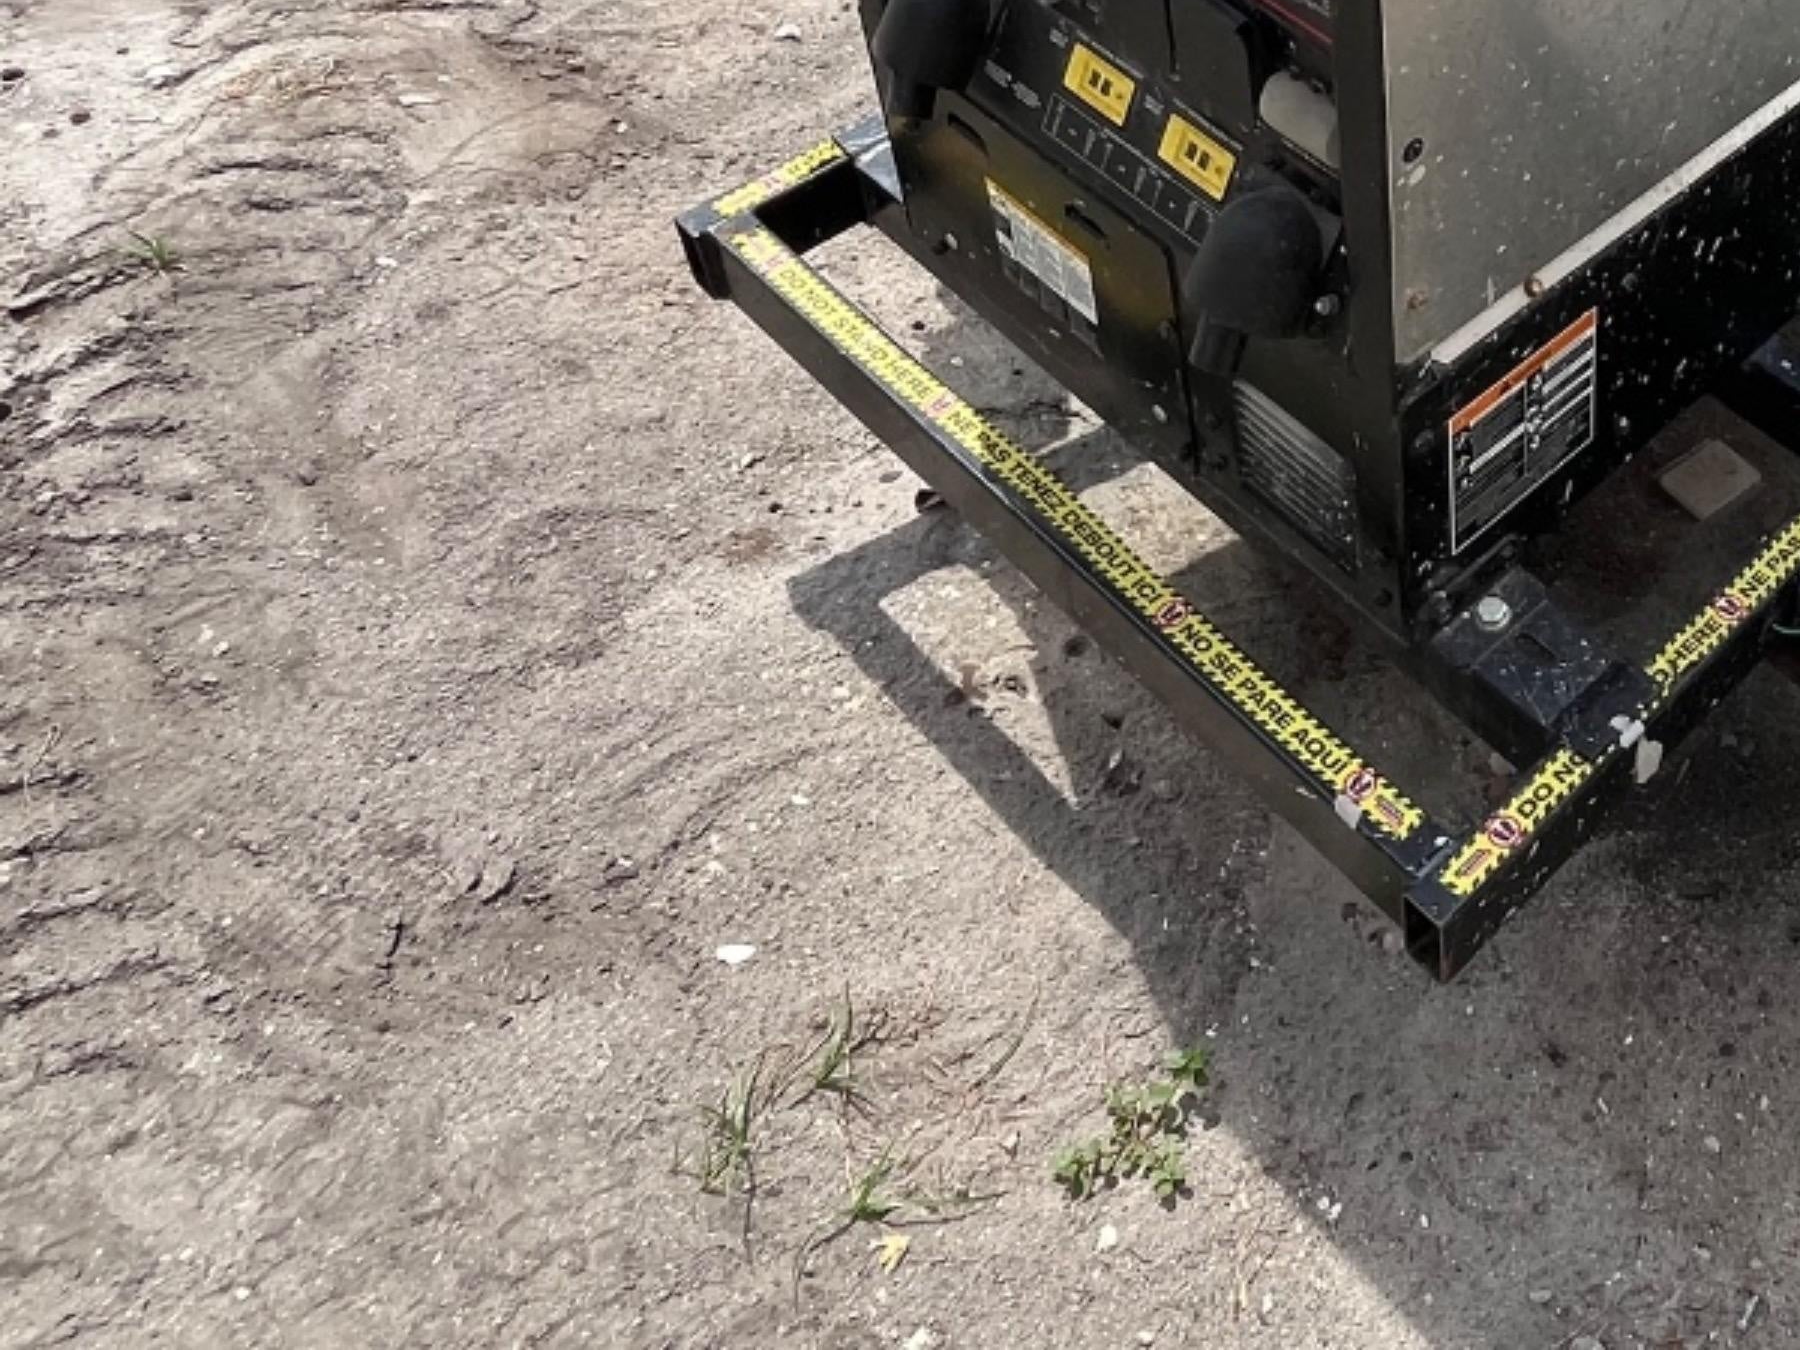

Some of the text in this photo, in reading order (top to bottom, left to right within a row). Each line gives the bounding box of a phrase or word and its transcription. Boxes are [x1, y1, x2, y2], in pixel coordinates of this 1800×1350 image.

[833, 317, 890, 362] STAD
[884, 358, 933, 399] HERE
[977, 430, 1012, 463] PAS
[1009, 461, 1067, 512] TENEZ
[1062, 508, 1139, 579] DEBOUT
[1131, 577, 1166, 603] ICI
[1178, 623, 1349, 775] NO SE PARE AQUI
[1517, 753, 1590, 819] DO NO
